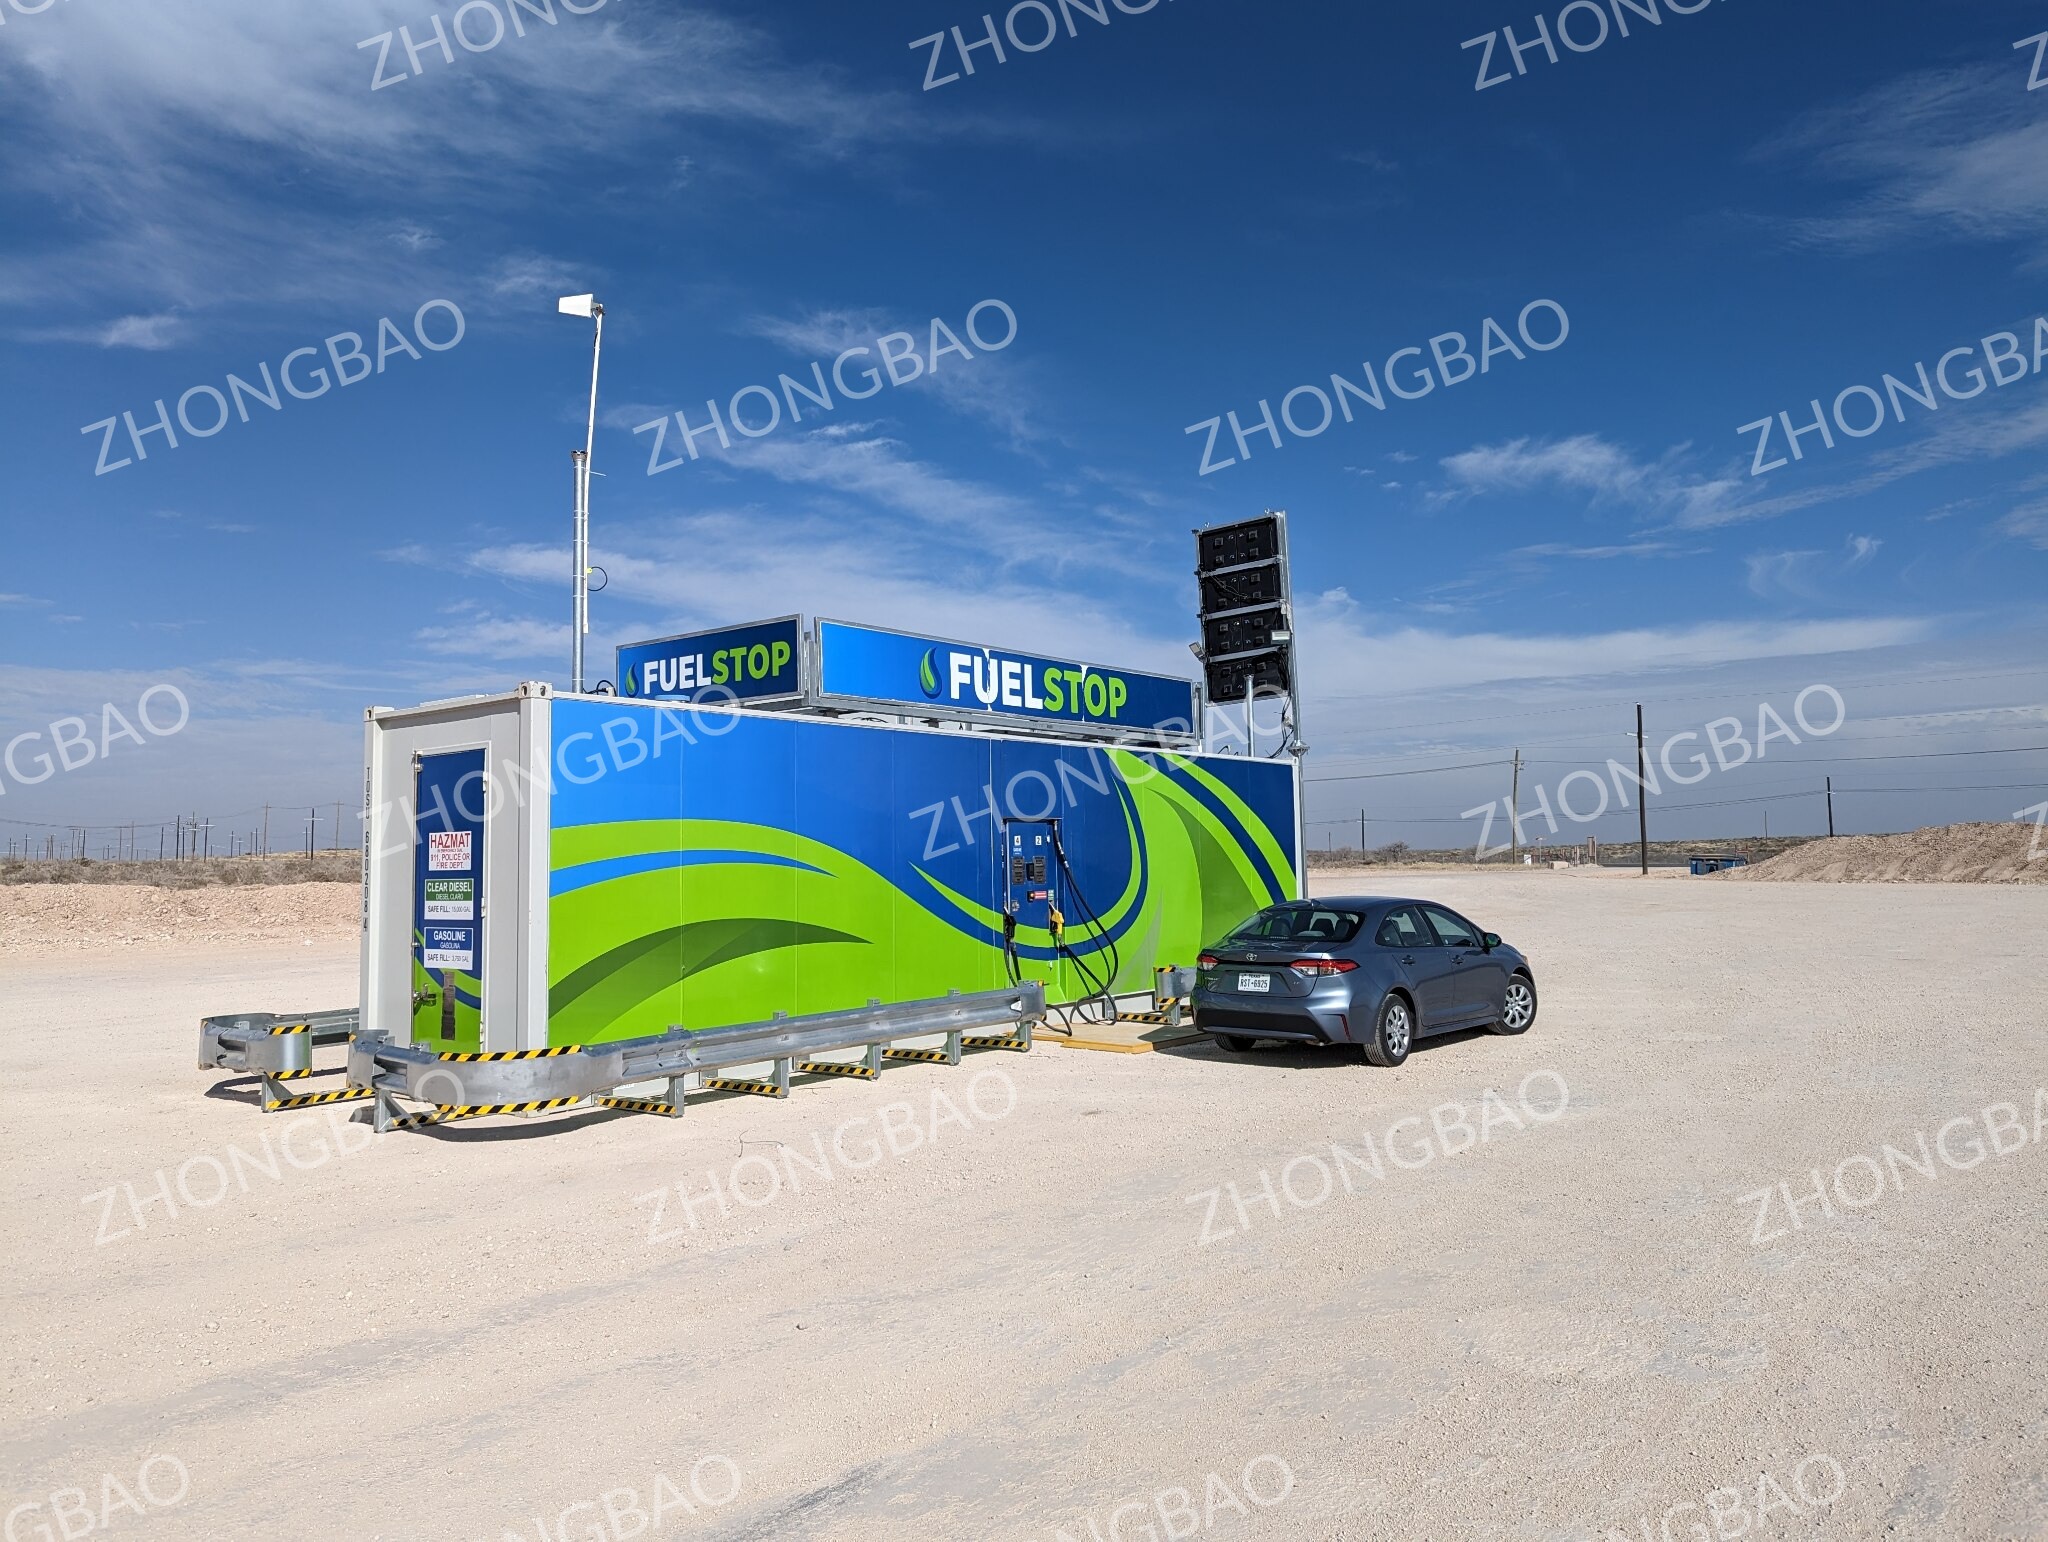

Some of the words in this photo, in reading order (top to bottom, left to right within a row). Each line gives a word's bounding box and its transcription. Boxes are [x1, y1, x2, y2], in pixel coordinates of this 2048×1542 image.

[430, 833, 471, 848] HAZMAT
[442, 853, 461, 861] POLICE
[462, 852, 471, 860] OR
[427, 882, 448, 892] CLEAR
[449, 882, 472, 892] DIESEL
[433, 930, 466, 941] GASOLINE
[428, 953, 439, 961] SAFE
